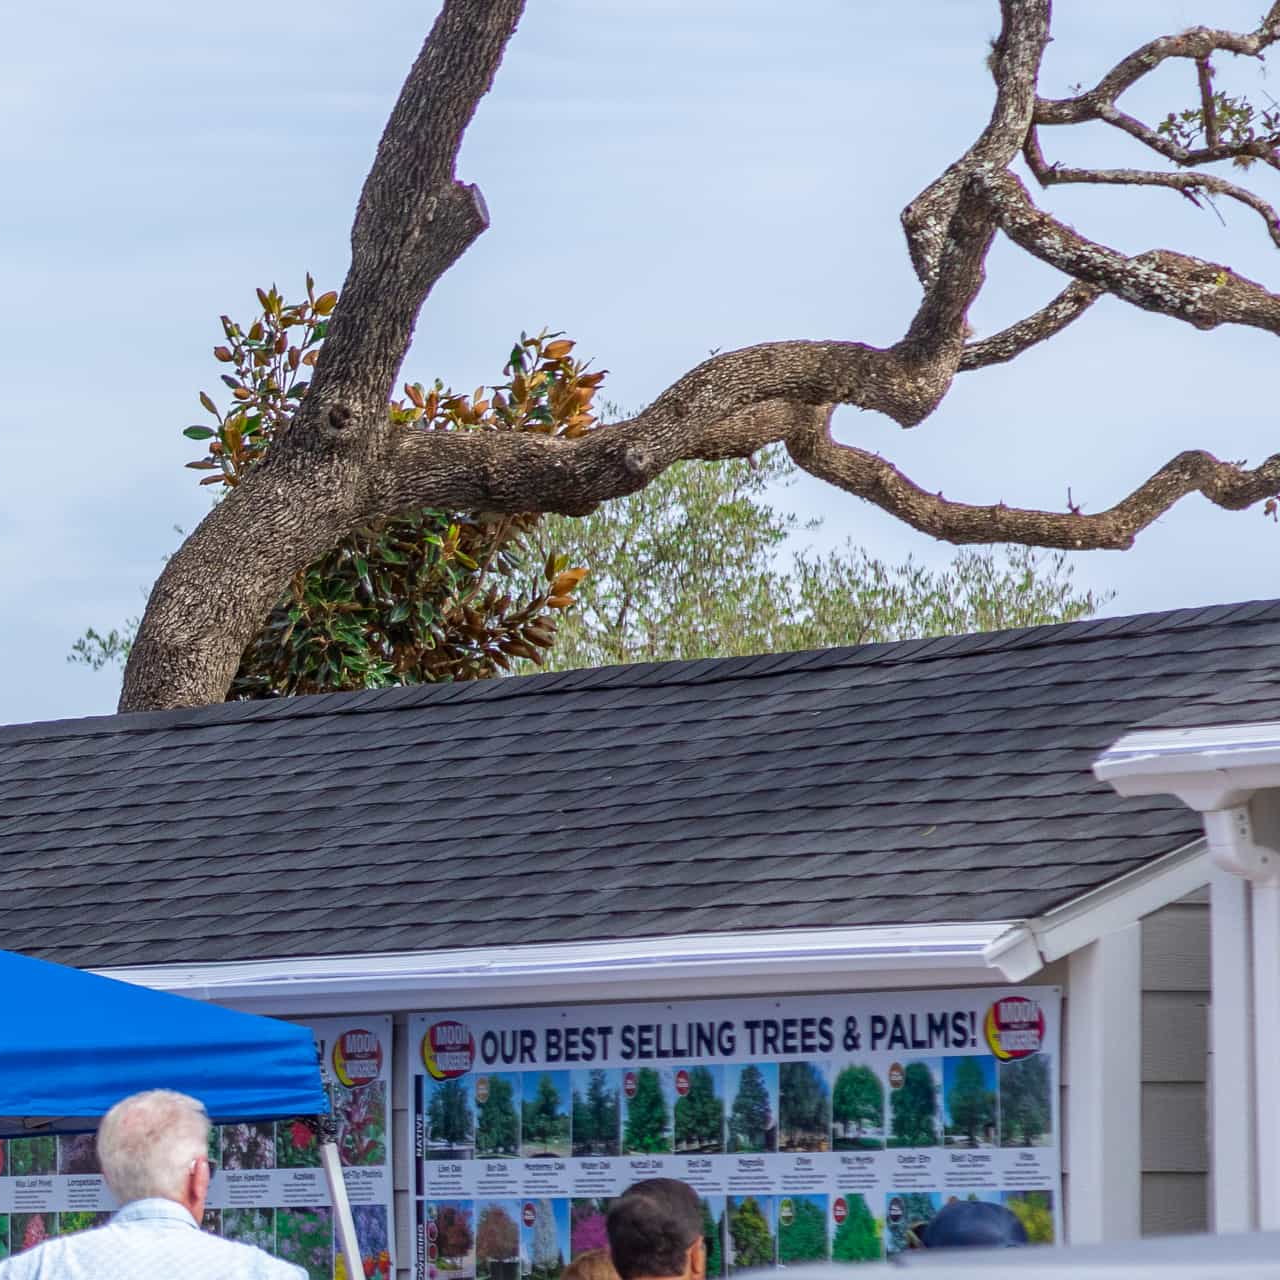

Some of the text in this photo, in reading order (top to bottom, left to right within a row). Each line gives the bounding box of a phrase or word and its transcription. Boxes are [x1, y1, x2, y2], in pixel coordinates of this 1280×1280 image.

[481, 1011, 976, 1065] OUR BEST SELLING TREES & PALMS!
[415, 1113, 424, 1158] NATIVE
